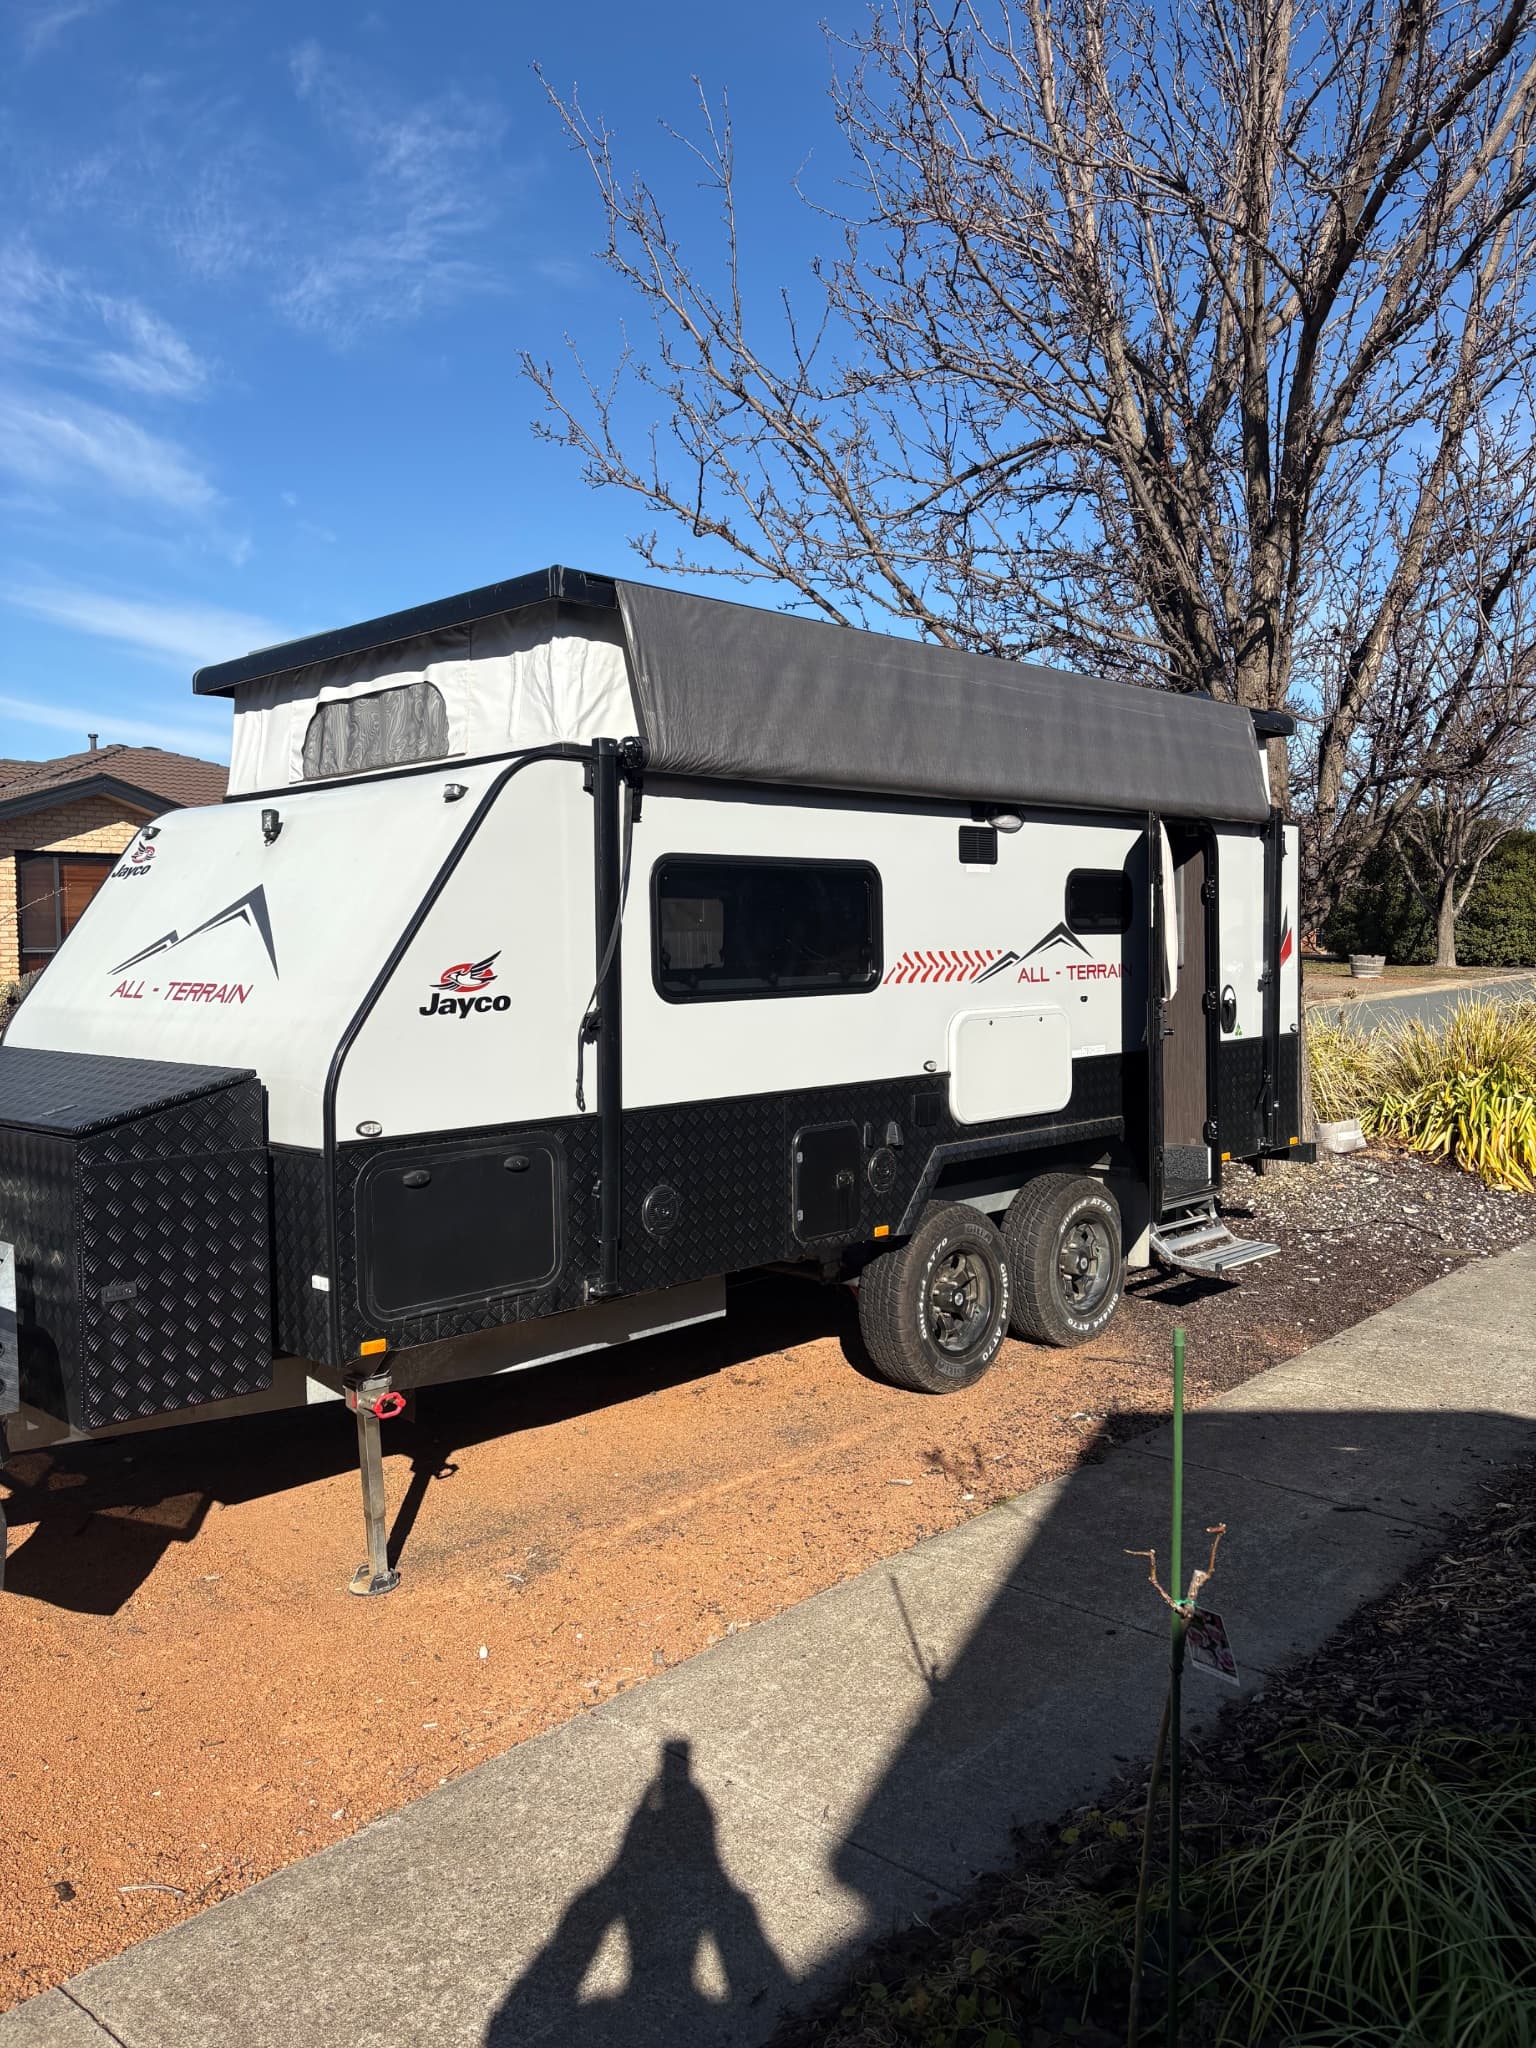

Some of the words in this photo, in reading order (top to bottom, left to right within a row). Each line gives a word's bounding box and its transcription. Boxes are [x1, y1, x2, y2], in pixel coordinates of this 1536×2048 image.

[111, 864, 151, 880] Jayco
[1017, 966, 1050, 983] ALL
[110, 980, 145, 999] ALL
[164, 982, 254, 1004] TERRAIN
[419, 993, 511, 1019] Jayco
[1090, 1198, 1112, 1213] AT70
[927, 1237, 948, 1273] AT70
[1067, 1317, 1090, 1331] AT70
[982, 1326, 1002, 1361] AT70
